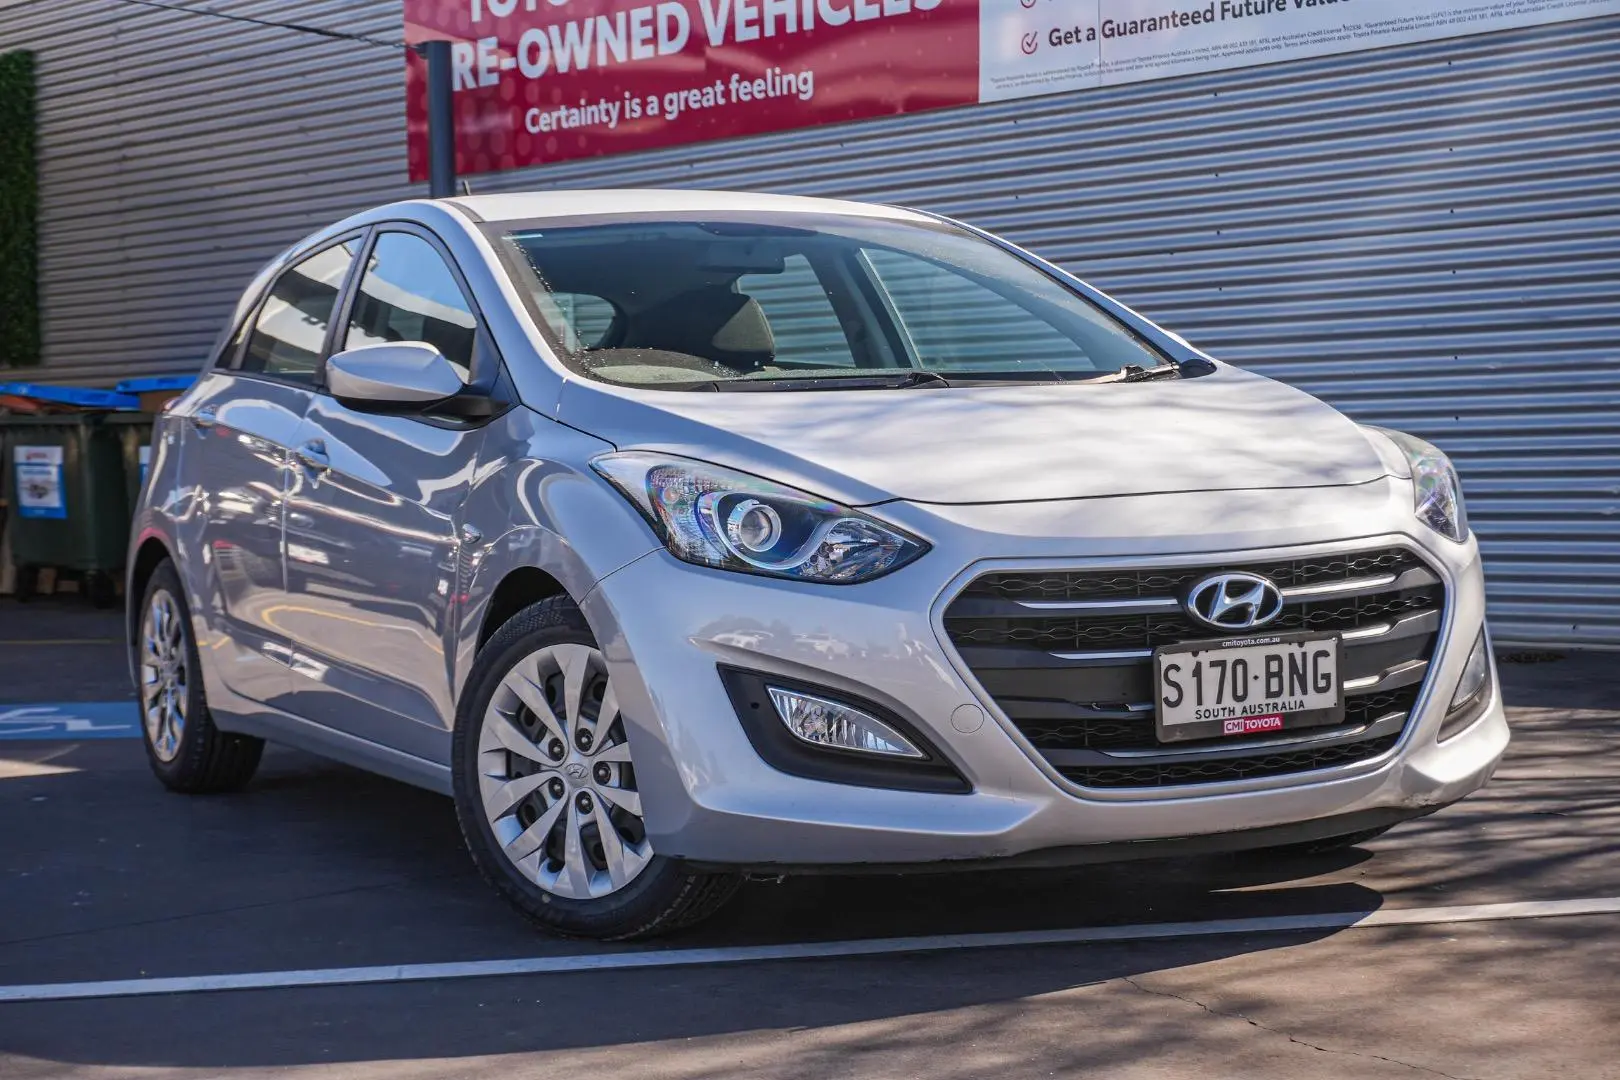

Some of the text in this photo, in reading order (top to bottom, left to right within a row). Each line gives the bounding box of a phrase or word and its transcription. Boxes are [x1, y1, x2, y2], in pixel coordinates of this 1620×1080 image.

[1048, 26, 1082, 47] Get
[1086, 27, 1096, 41] a
[1101, 1, 1215, 39] Guaranteed
[1220, 0, 1287, 20] Future
[452, 2, 691, 91] RE-OWNED
[525, 67, 813, 134] Certainty is a great feeling
[1222, 637, 1280, 648] cmitoyota.com.au
[1195, 700, 1305, 720] SOUTH AUSTRALIA
[1225, 717, 1281, 732] CMI TOYOTA
